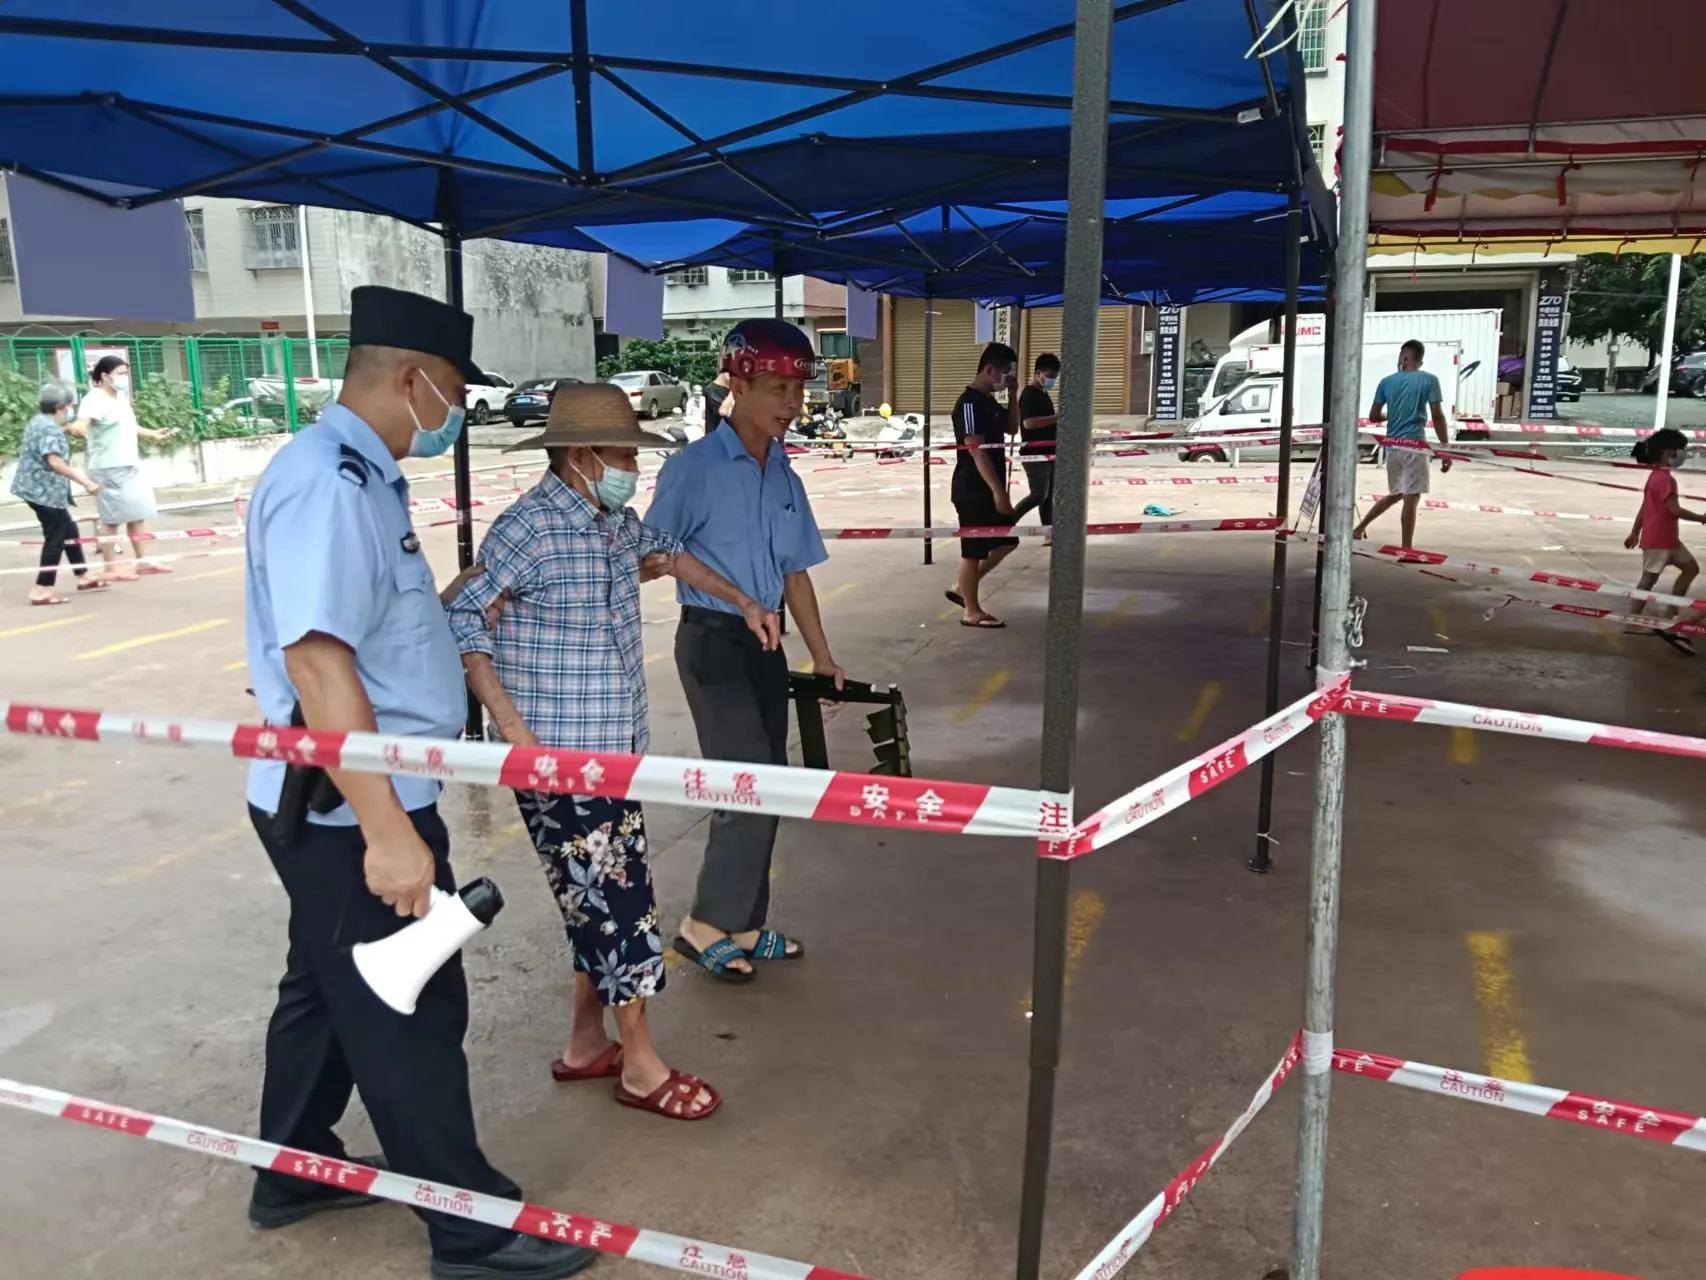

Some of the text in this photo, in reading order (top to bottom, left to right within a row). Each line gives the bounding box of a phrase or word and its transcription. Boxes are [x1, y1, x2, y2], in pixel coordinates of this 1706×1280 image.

[1538, 295, 1562, 305] ZTO
[1471, 713, 1544, 733] CAUTION
[682, 767, 759, 794] 注意
[1200, 756, 1235, 784] SAFE
[684, 787, 763, 807] CAUTION
[861, 783, 945, 816] 安全
[849, 804, 929, 824] SAFE
[1039, 801, 1068, 828] 注
[1439, 1080, 1505, 1102] CAUTION
[80, 1107, 130, 1129] SAFE
[1577, 1109, 1646, 1133] SAFE
[186, 1130, 239, 1156] CAUTION
[294, 1160, 348, 1184] SAFE
[414, 1190, 473, 1216] CAUTION
[539, 1220, 600, 1247] SAFE
[679, 1256, 749, 1280] CAUTION
